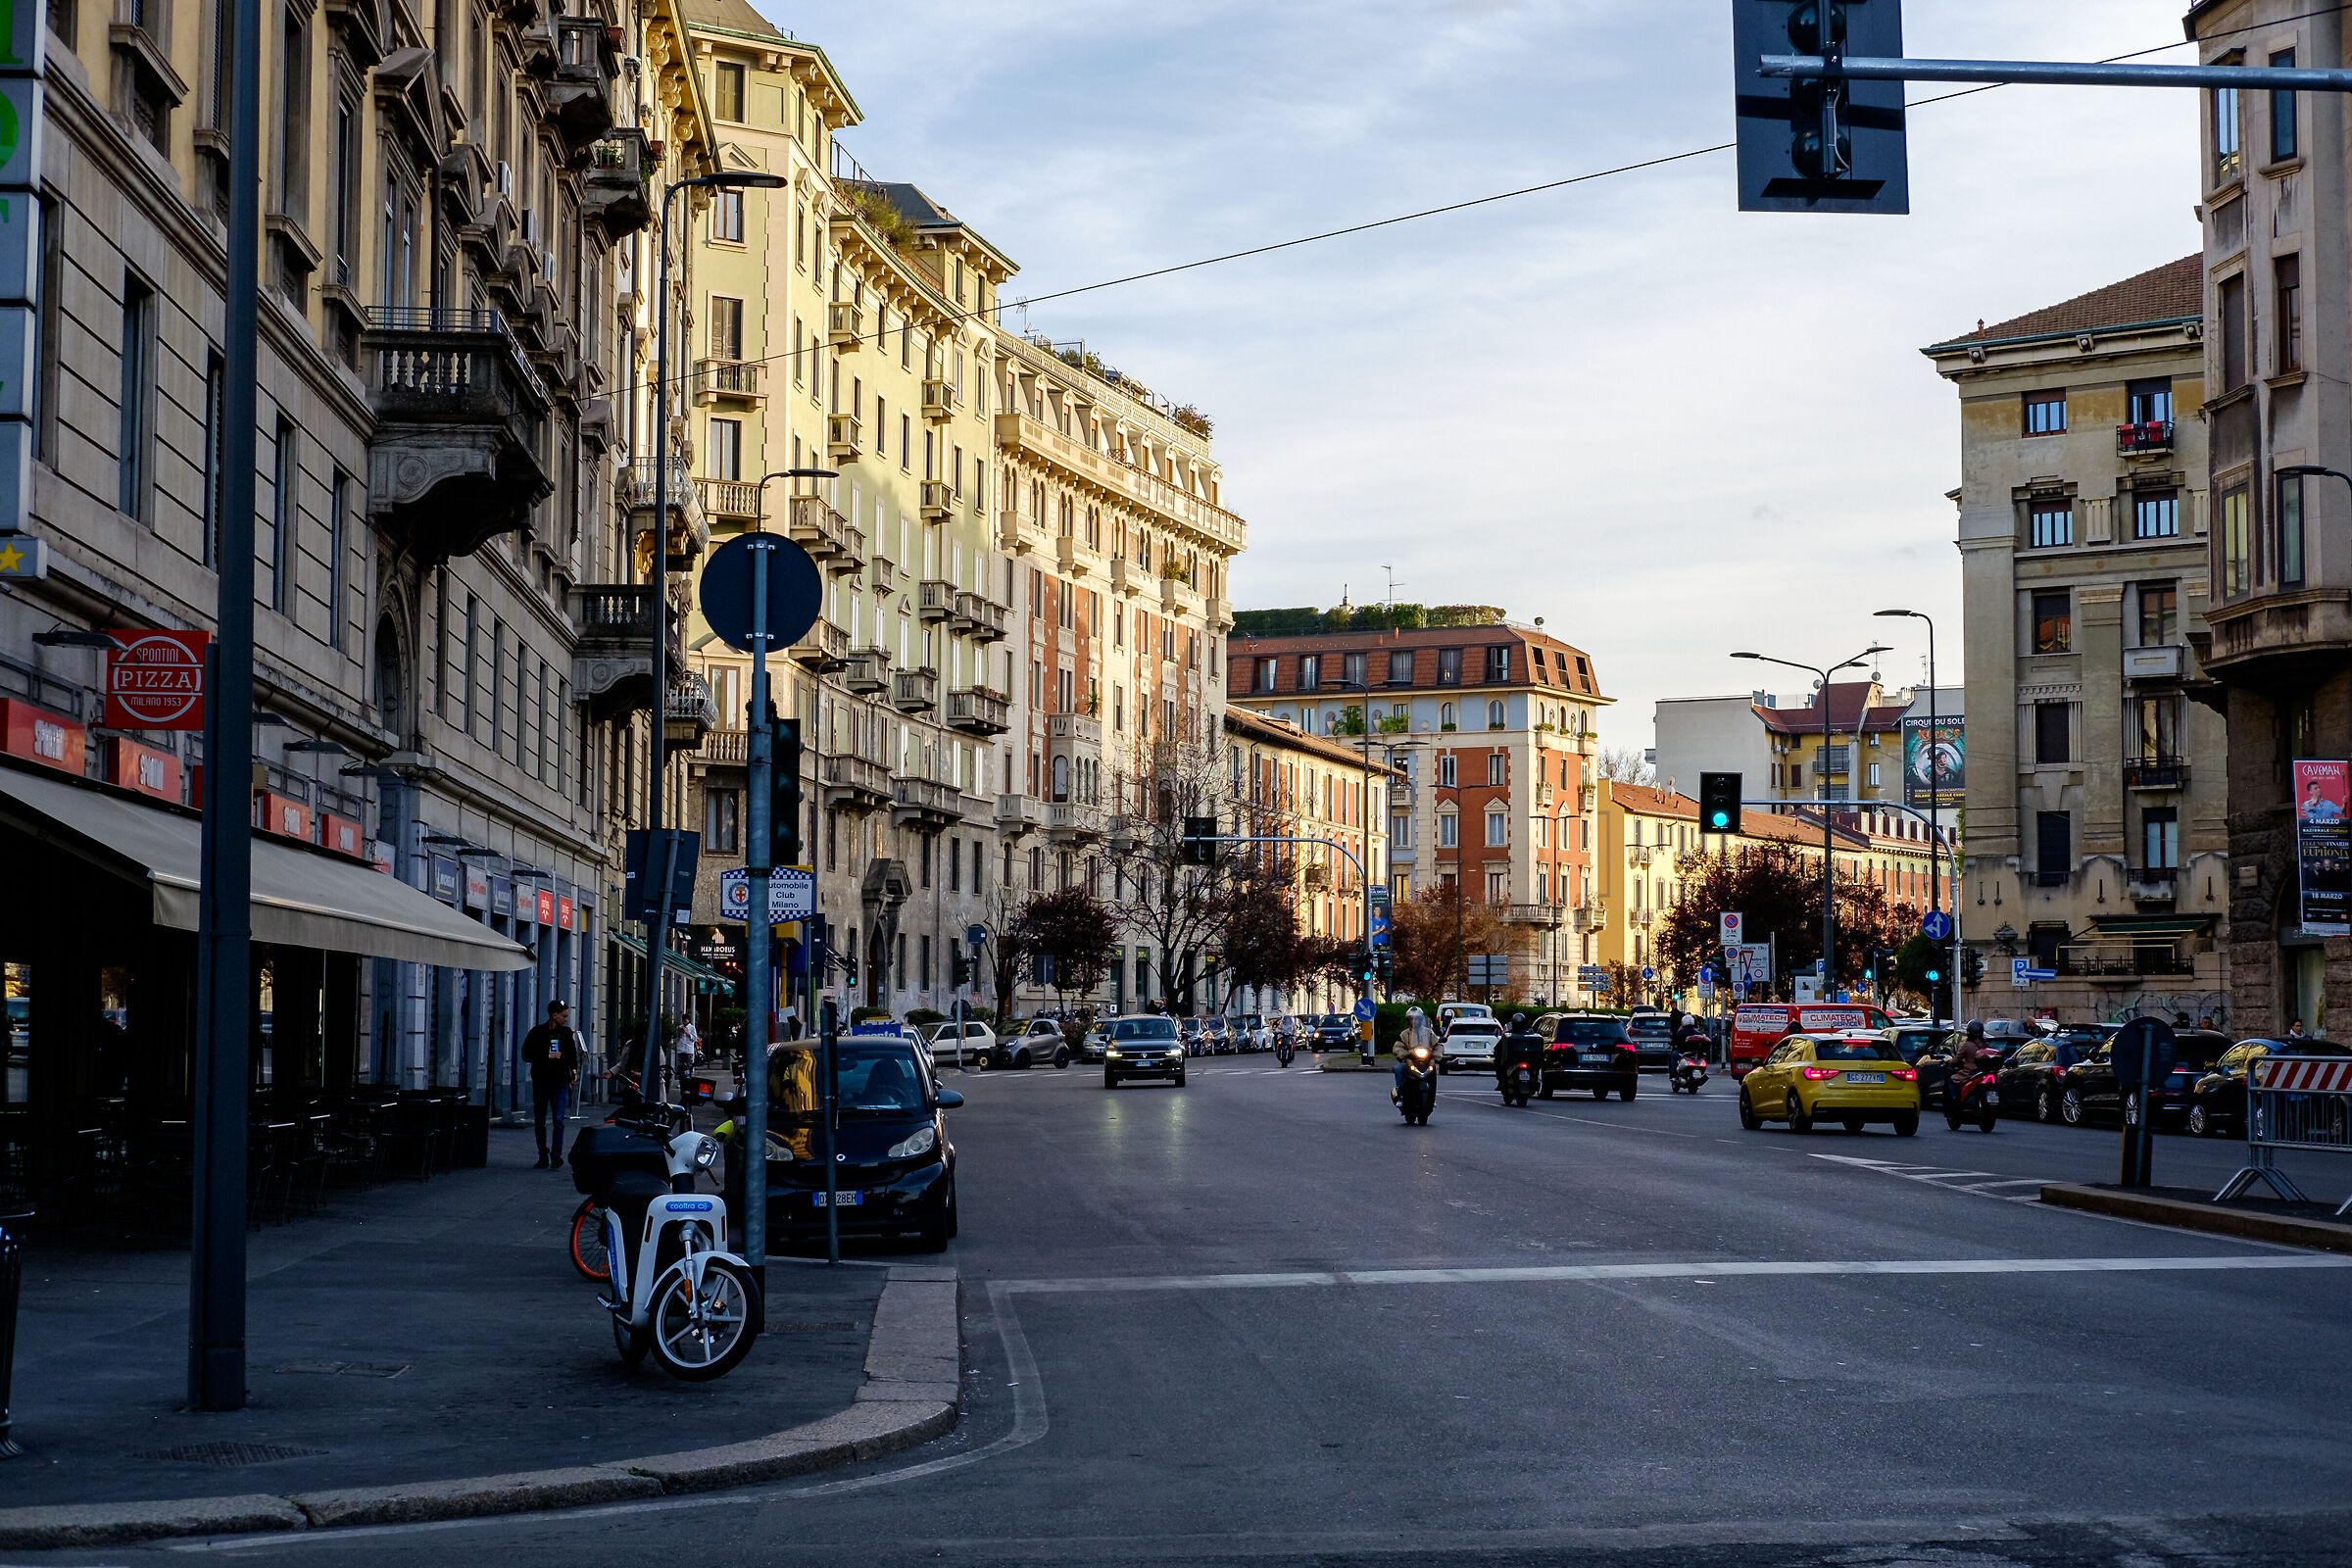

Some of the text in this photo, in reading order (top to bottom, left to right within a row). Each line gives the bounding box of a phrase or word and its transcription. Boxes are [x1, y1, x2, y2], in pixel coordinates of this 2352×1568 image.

[136, 648, 179, 662] SPONTINI
[121, 670, 193, 688] PIZZA
[130, 697, 181, 707] MILANO 1953
[2302, 765, 2340, 776] CAVEMAN
[2303, 848, 2350, 857] EUPHONIA
[1810, 1013, 1857, 1022] CLIMATECH
